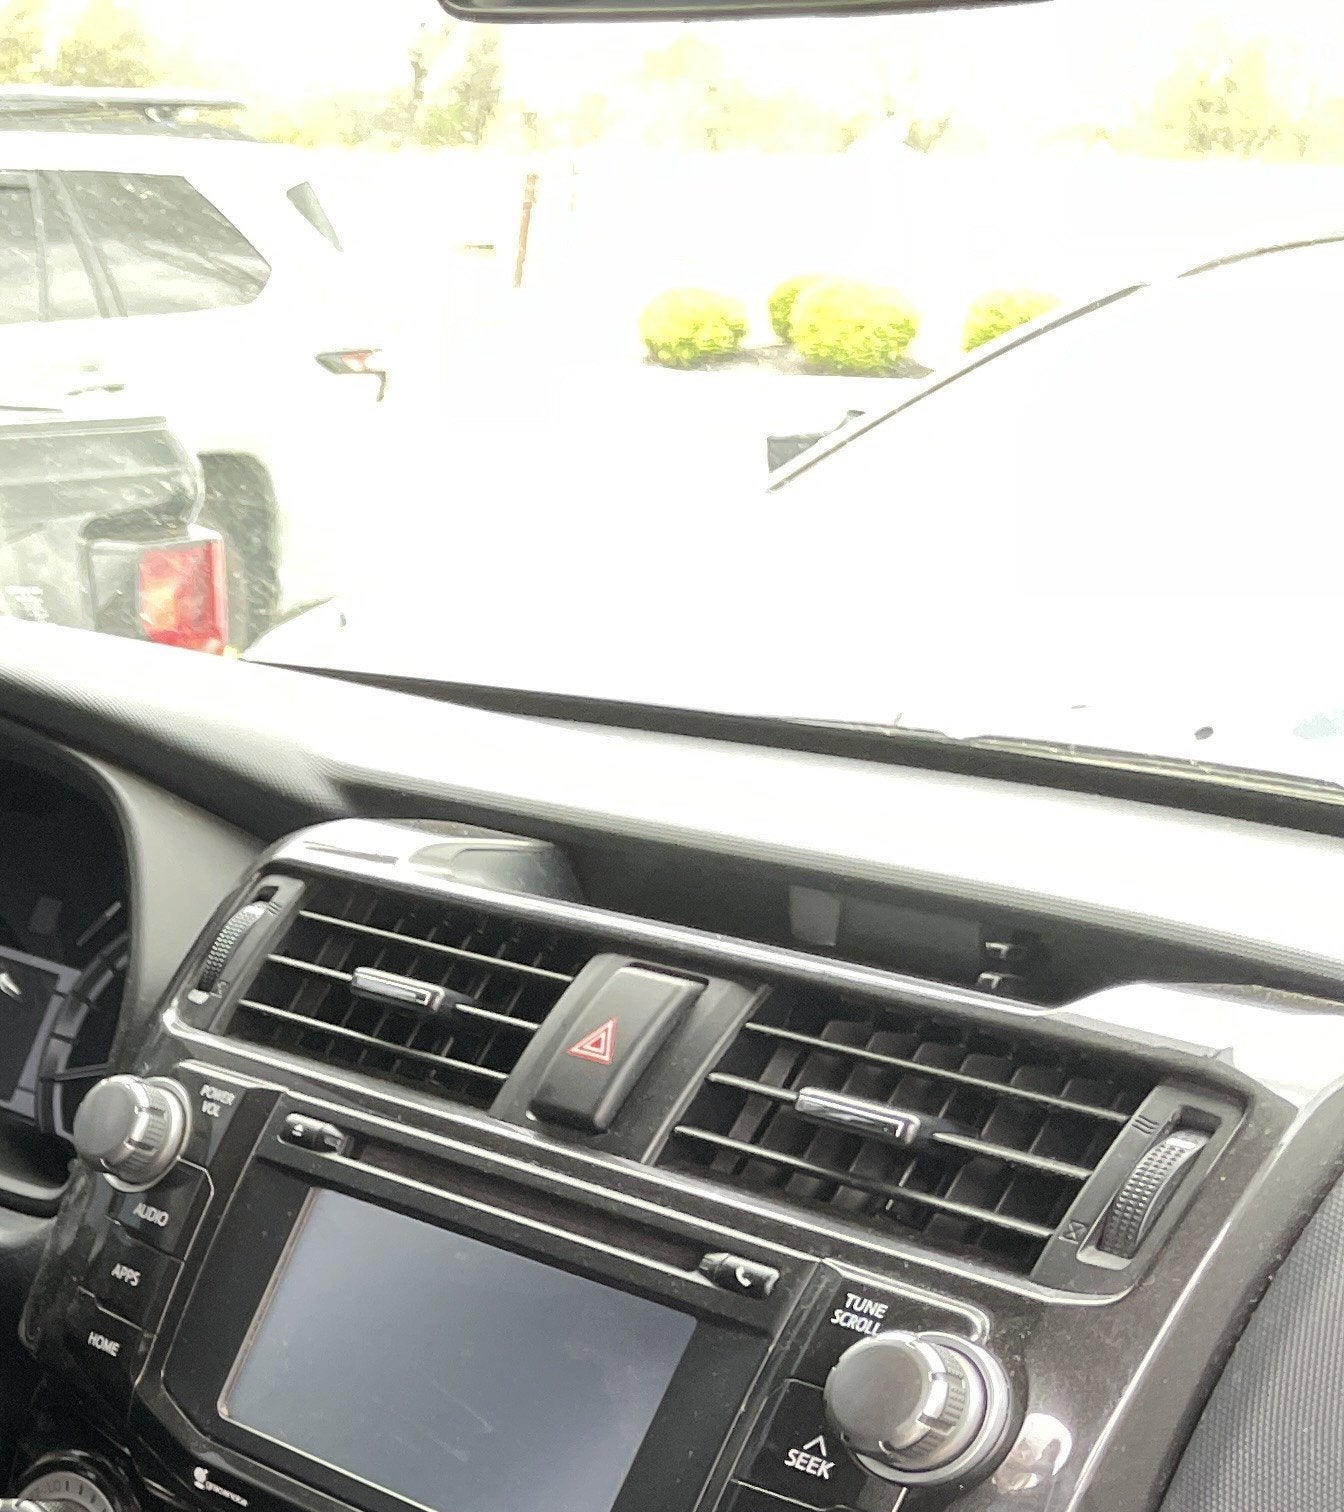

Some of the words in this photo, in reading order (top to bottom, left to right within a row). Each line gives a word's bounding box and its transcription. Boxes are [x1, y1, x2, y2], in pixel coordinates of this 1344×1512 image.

[133, 1202, 169, 1227] AUDIO
[111, 1263, 141, 1287] APPS
[845, 1292, 889, 1319] TUNE
[830, 1309, 882, 1337] SCROLL
[87, 1331, 120, 1357] HOME
[783, 1448, 835, 1480] SEEK
